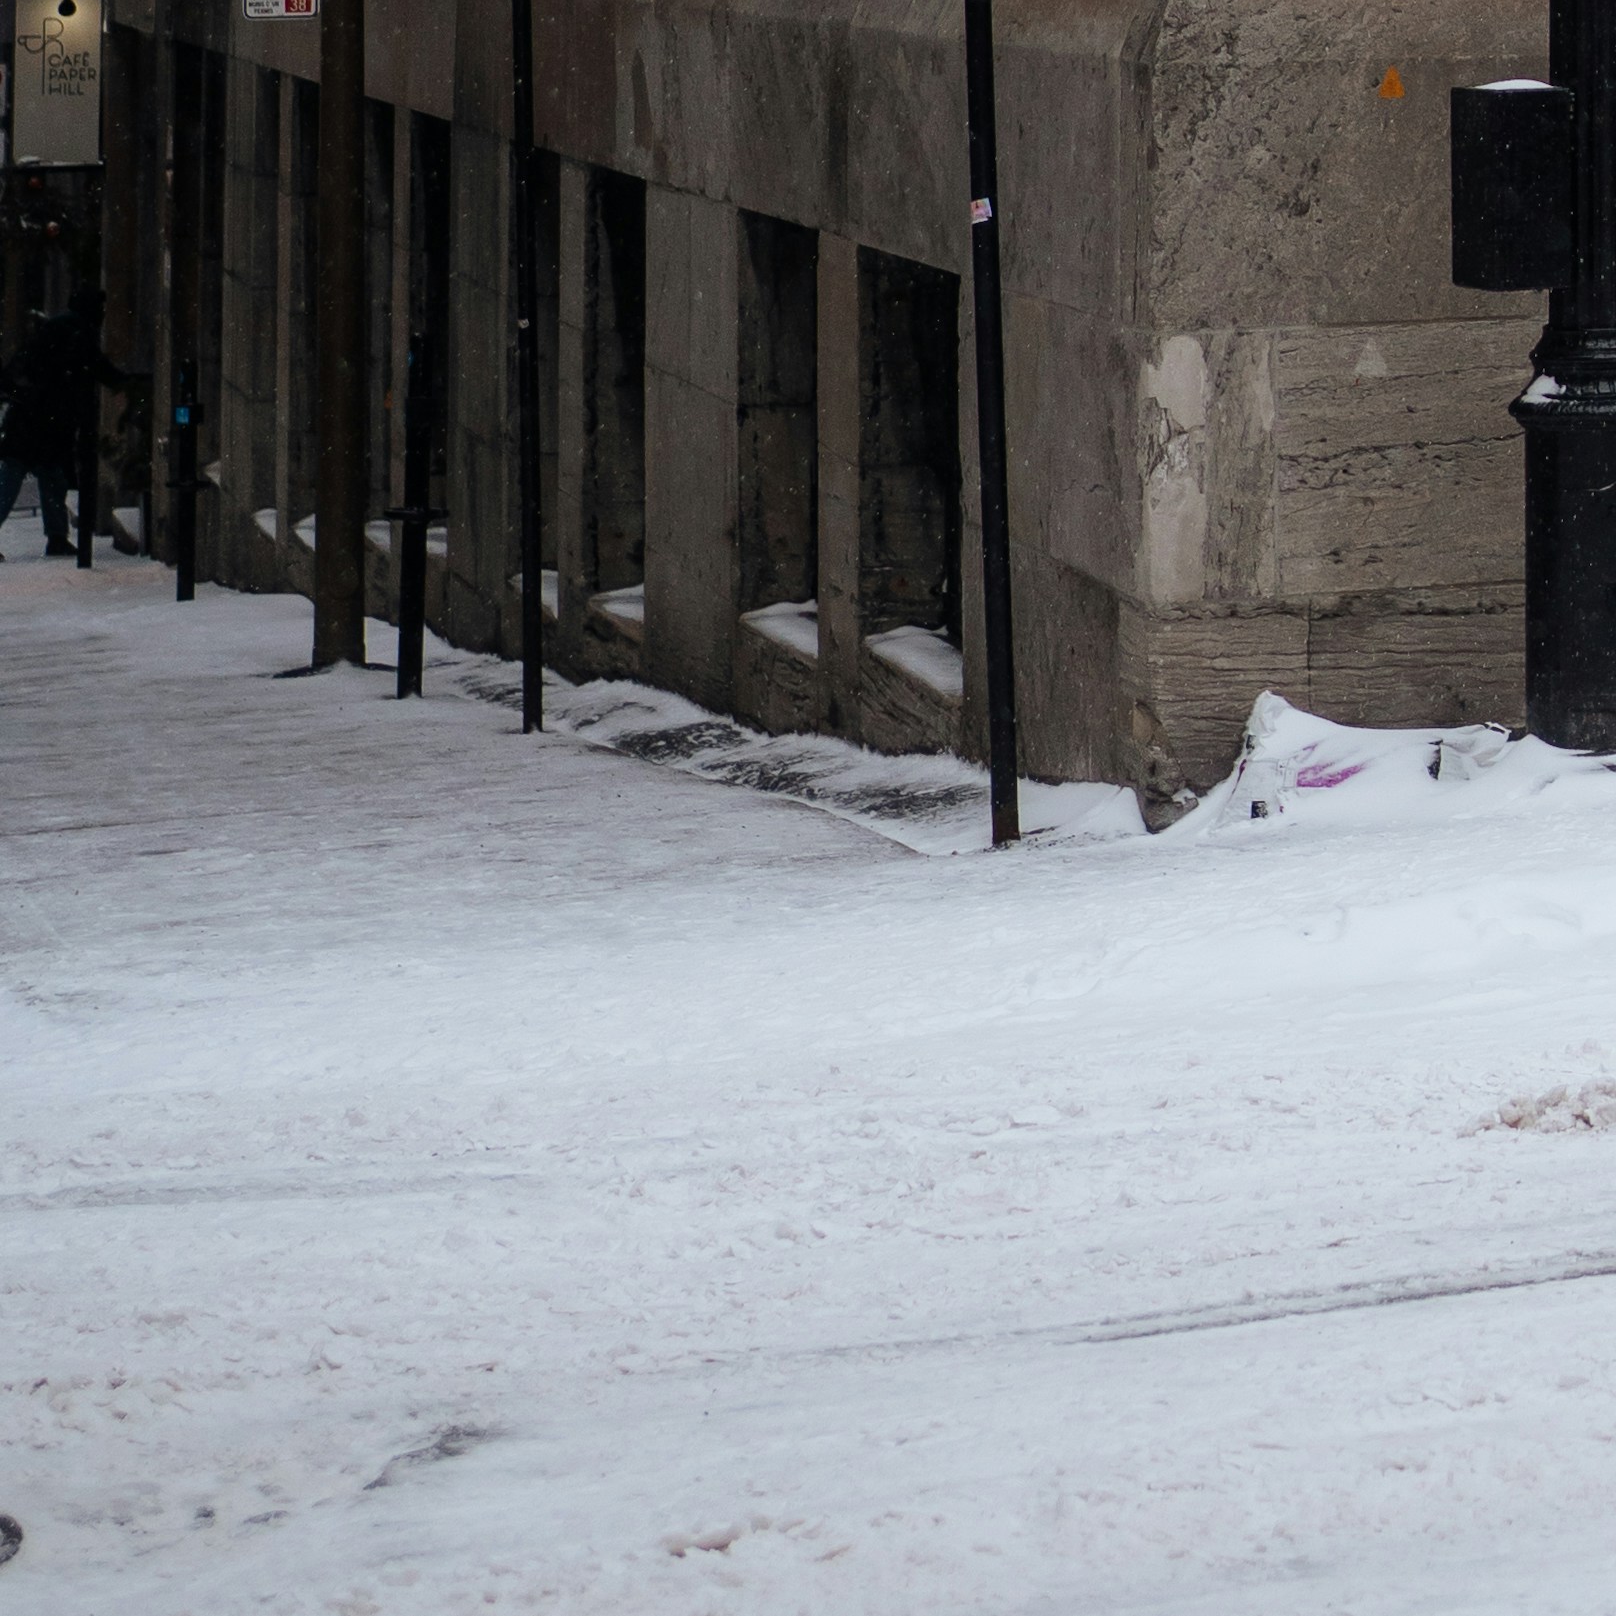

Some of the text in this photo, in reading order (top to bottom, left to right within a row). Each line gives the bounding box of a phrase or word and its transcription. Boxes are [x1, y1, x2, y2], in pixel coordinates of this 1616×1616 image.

[48, 51, 90, 67] CAFÉ
[49, 67, 97, 81] PAPER
[49, 82, 84, 96] HILL
